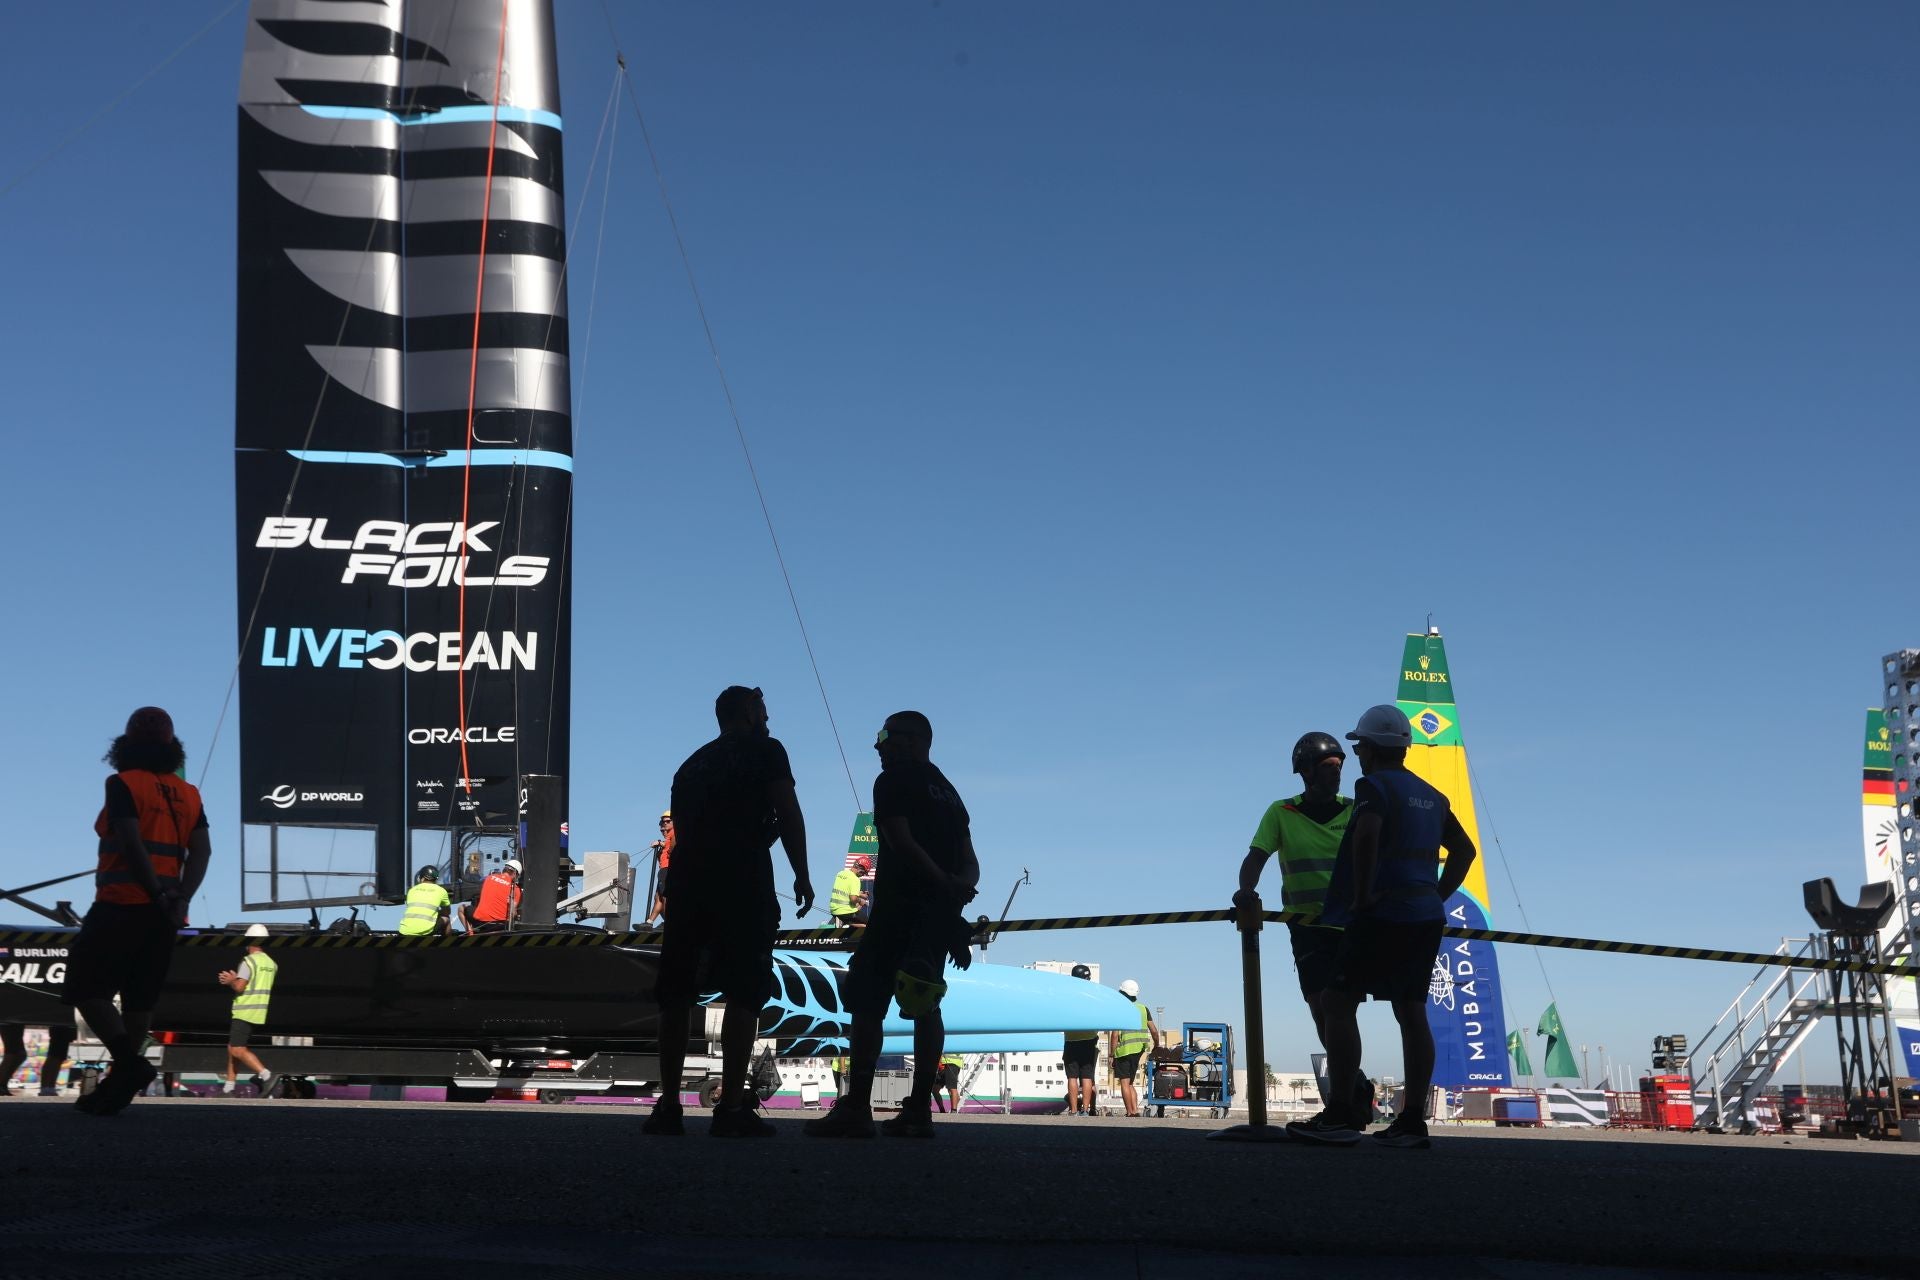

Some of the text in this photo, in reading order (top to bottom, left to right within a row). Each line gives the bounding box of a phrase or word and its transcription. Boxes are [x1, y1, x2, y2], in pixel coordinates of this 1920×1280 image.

[255, 517, 501, 554] BLACK
[340, 553, 550, 588] FOILS
[1404, 670, 1447, 683] ROLEX
[408, 726, 516, 744] ORACLE
[301, 792, 364, 801] DP WORLD
[13, 948, 69, 957] BURLING
[1450, 904, 1486, 1061] MUBADAA
